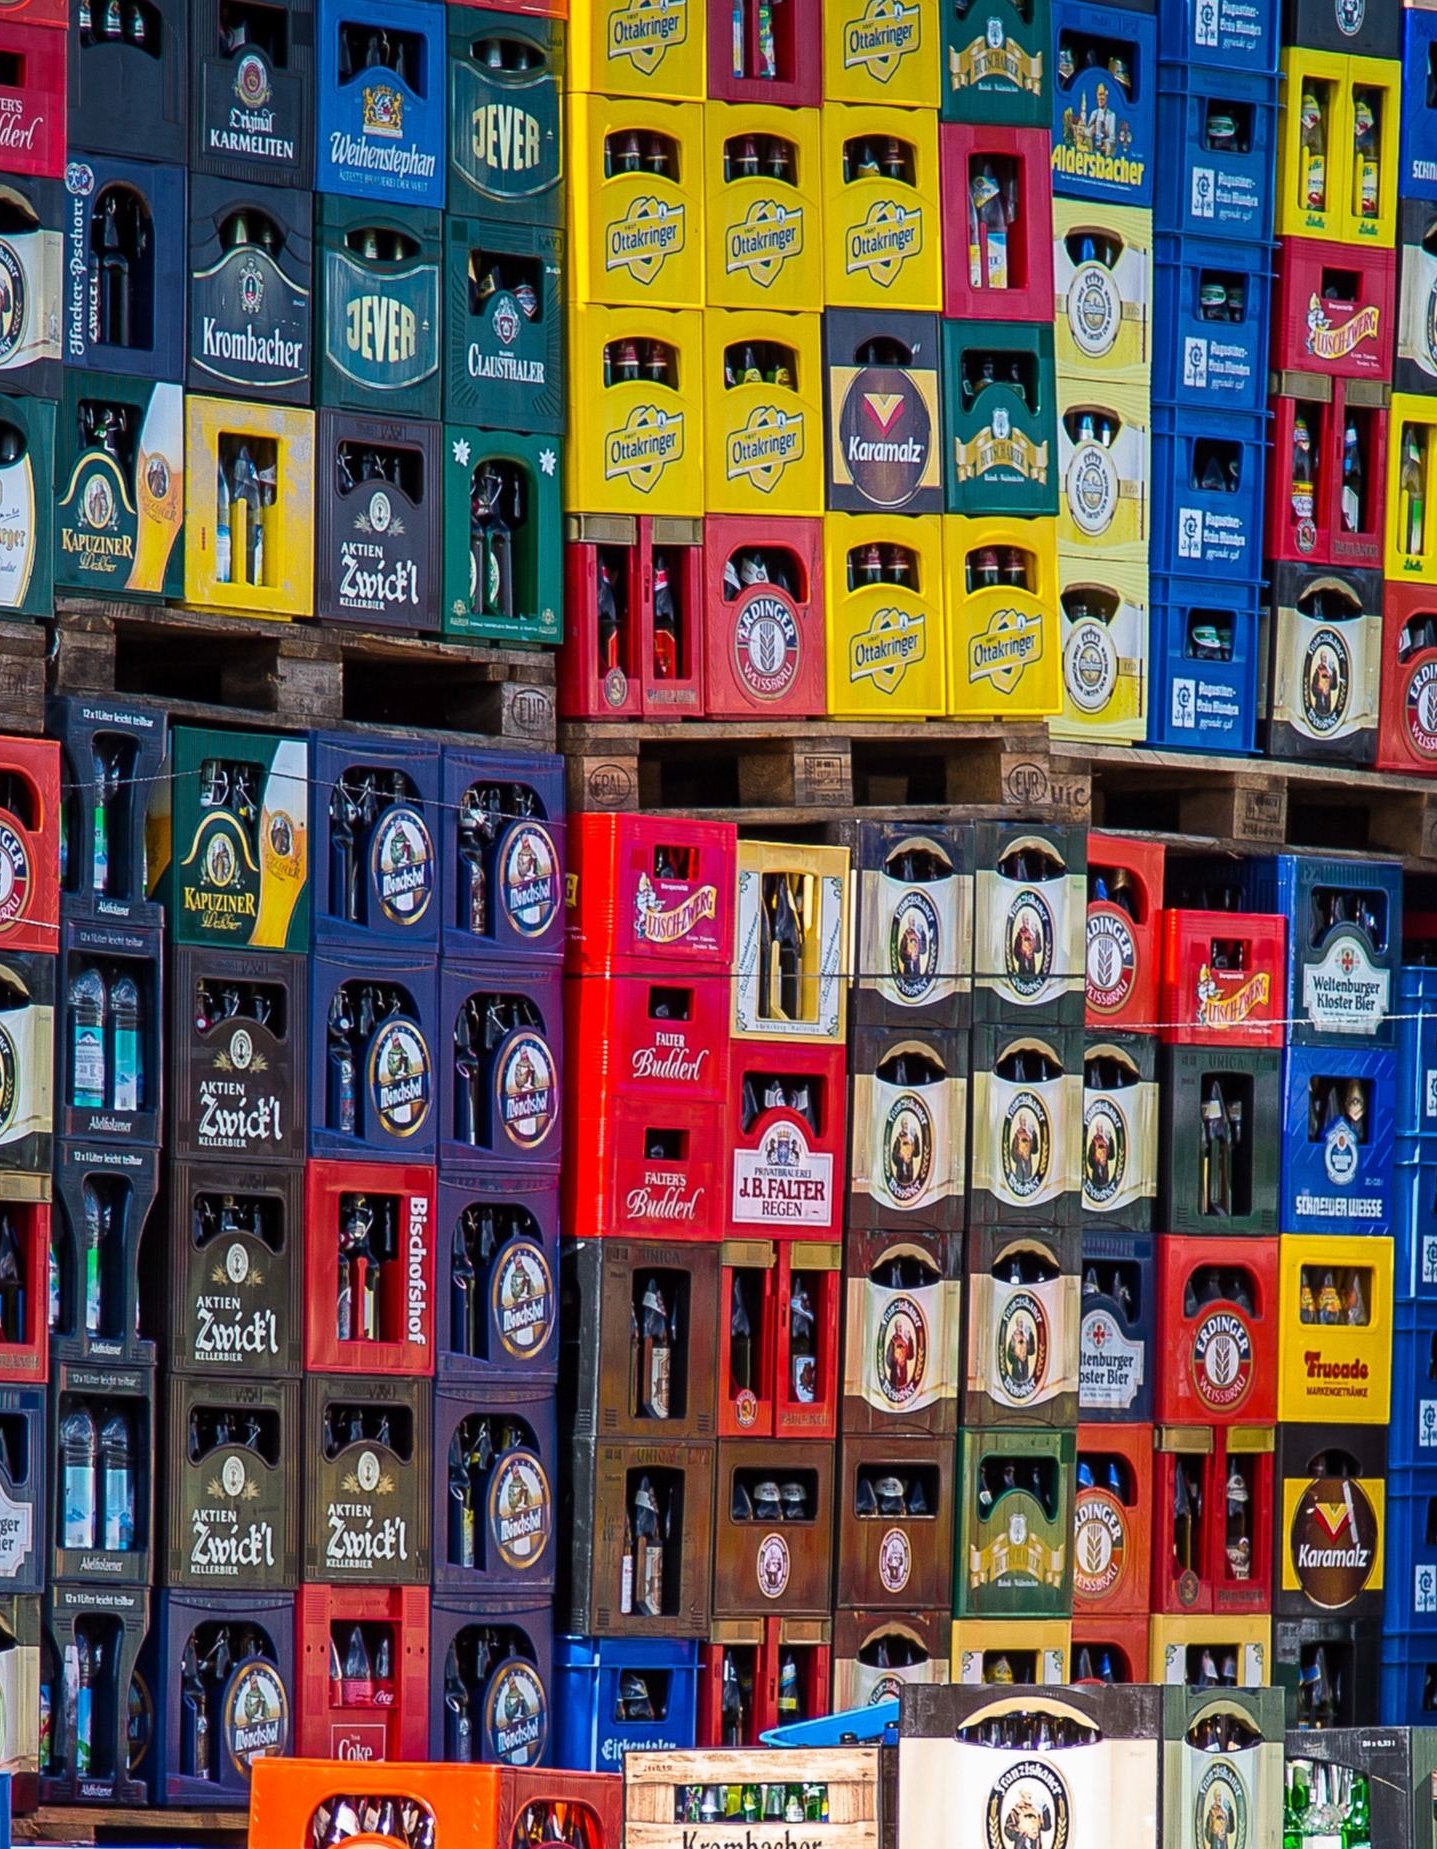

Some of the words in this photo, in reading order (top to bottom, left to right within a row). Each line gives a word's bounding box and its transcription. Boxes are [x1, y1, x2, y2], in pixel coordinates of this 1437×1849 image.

[612, 9, 682, 40] Ottakringer
[230, 108, 277, 136] Original
[471, 103, 540, 169] JEVER
[209, 128, 294, 160] KARMELITEN
[330, 132, 437, 177] Weihenstephan
[1050, 143, 1144, 186] Aldersbacher
[611, 221, 679, 251] Ottakringer
[850, 223, 917, 254] Ottakringer
[69, 198, 84, 355] Hacker-Pschorr
[203, 317, 303, 369] Krombacher
[1316, 310, 1376, 356] LÖSCH-ZWERG
[467, 344, 546, 385] CLAUSTHALER
[848, 435, 921, 464] Karamalz
[341, 541, 383, 558] AKTIEN
[340, 549, 420, 604] Zwick'l
[339, 598, 386, 611] KELLERBIER
[736, 599, 797, 645] ERDINGER
[973, 632, 1040, 664] Ottakringer
[741, 658, 796, 691] WEISSBRÄU
[382, 866, 426, 895] Mönchshof
[183, 887, 256, 917] KAPUZINER
[646, 887, 715, 939] LÖSCH-ZWERG
[655, 1031, 685, 1049] FALTER
[631, 1048, 709, 1082] Budderl
[754, 1166, 812, 1180] PRIVATBRAUEREI
[767, 1179, 826, 1201] FALTER
[761, 1201, 803, 1218] REGEN
[408, 1196, 428, 1345] Bischofshof
[1307, 1385, 1368, 1398] MARKENGETRÄNKE
[499, 1517, 543, 1544] Mönchshof
[338, 1738, 373, 1762] Coke
[994, 1760, 1062, 1796] Franziskaner
